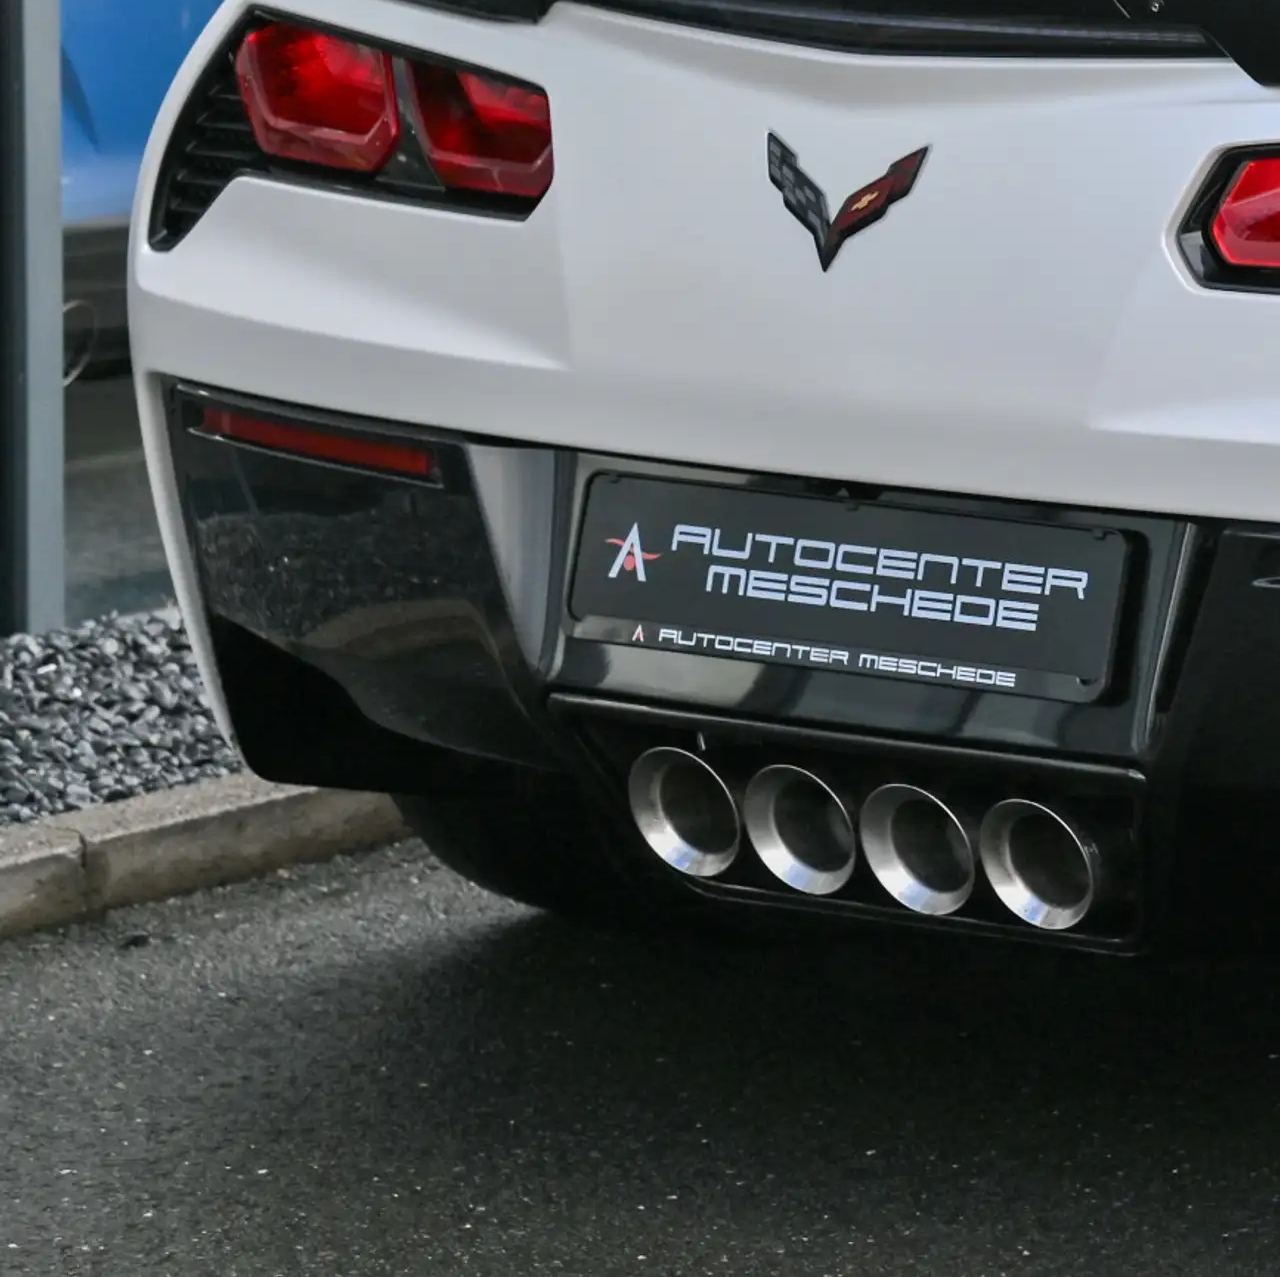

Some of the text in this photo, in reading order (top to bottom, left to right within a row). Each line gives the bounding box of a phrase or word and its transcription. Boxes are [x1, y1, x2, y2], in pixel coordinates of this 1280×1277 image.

[671, 524, 1088, 600] AUTOCENTER
[705, 564, 1040, 631] MESCHEDE
[658, 628, 1015, 687] AUTOCENTER MESCHEDE
